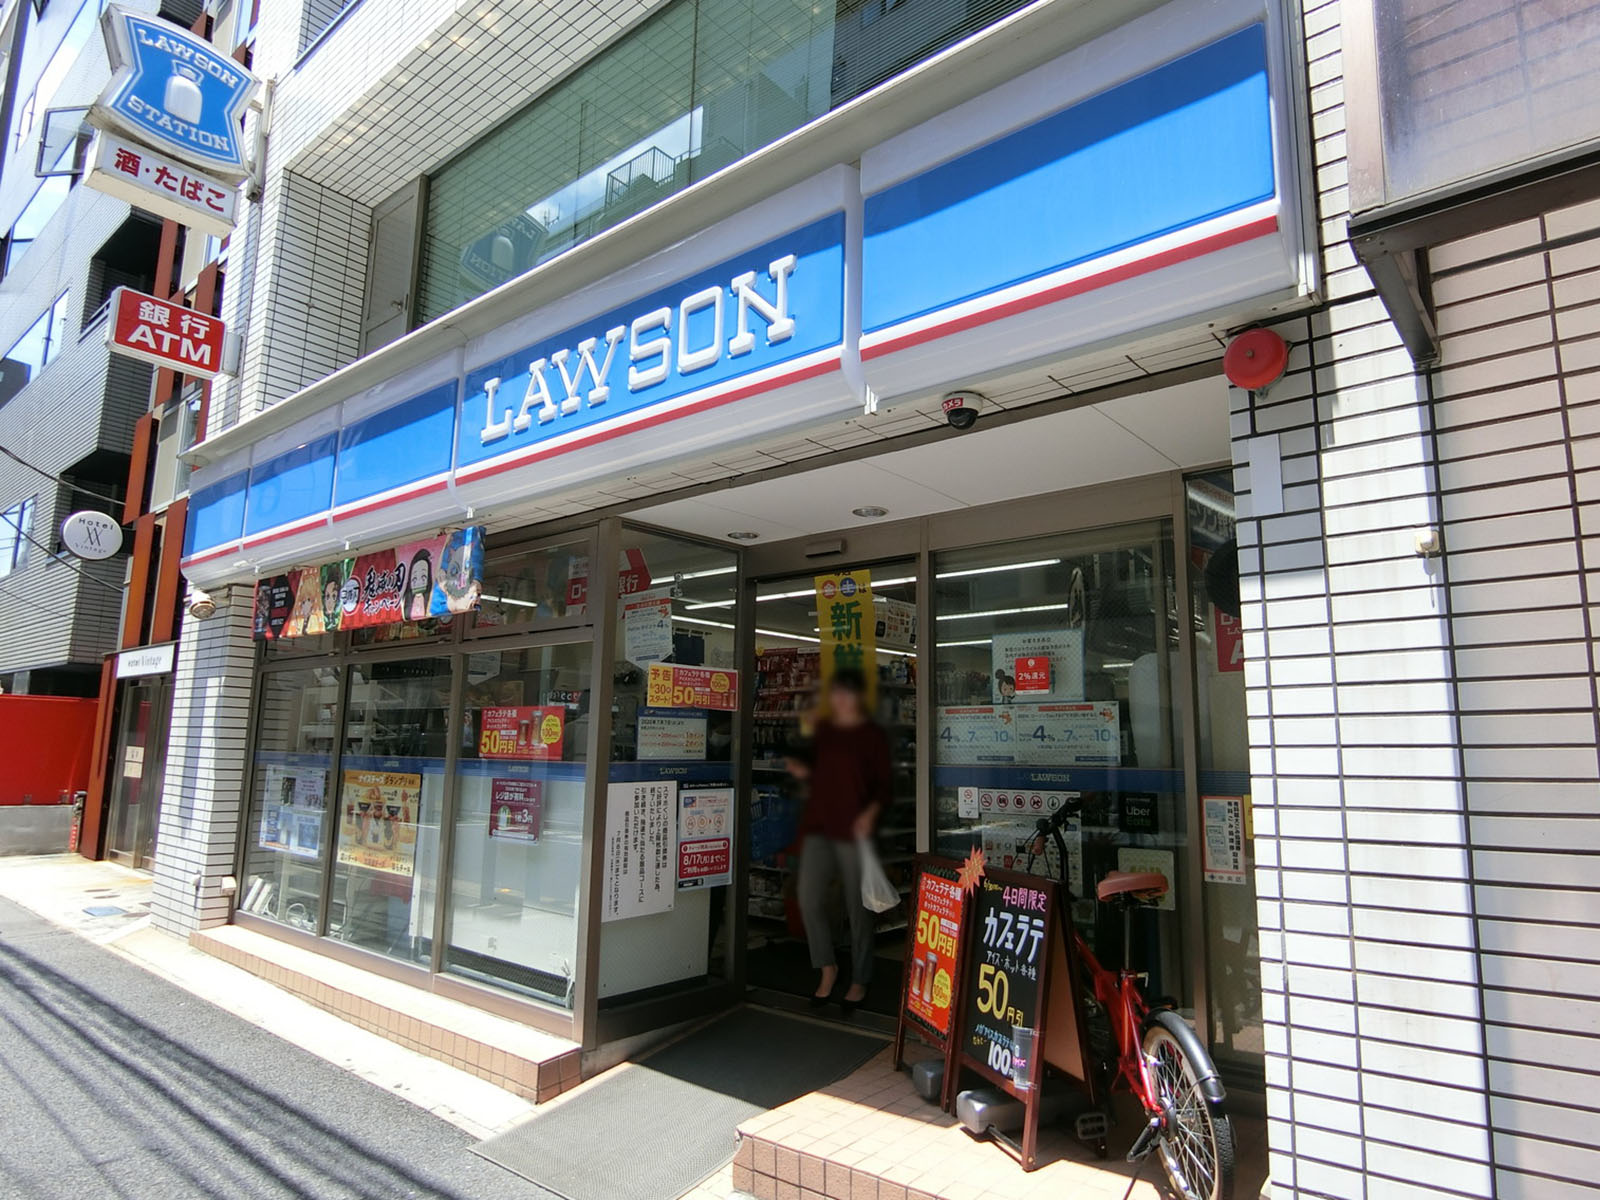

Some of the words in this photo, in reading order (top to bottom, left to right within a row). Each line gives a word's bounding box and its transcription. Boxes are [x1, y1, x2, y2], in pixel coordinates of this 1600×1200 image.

[137, 28, 240, 89] LAWSON
[127, 95, 232, 152] STATION
[114, 147, 226, 213] 酒・たばこ
[139, 300, 210, 340] 銀行
[127, 324, 212, 366] ATM
[480, 253, 798, 445] LAWSON
[78, 517, 114, 531] Hotel
[650, 668, 671, 682] 予告
[1018, 672, 1046, 681] 2%還元
[673, 686, 711, 705] 50円引
[481, 730, 517, 754] 50円引
[660, 767, 688, 775] LAWSON
[1031, 773, 1071, 783] LAWSON
[1126, 806, 1151, 816] Uber
[926, 879, 962, 902] カフェラテ各種
[1003, 886, 1047, 913] 4日間限定
[917, 910, 957, 960] 50円引
[983, 907, 1044, 963] カフェラテ
[986, 950, 1037, 981] アイス・ホット各種
[976, 963, 1024, 1029] 50円引
